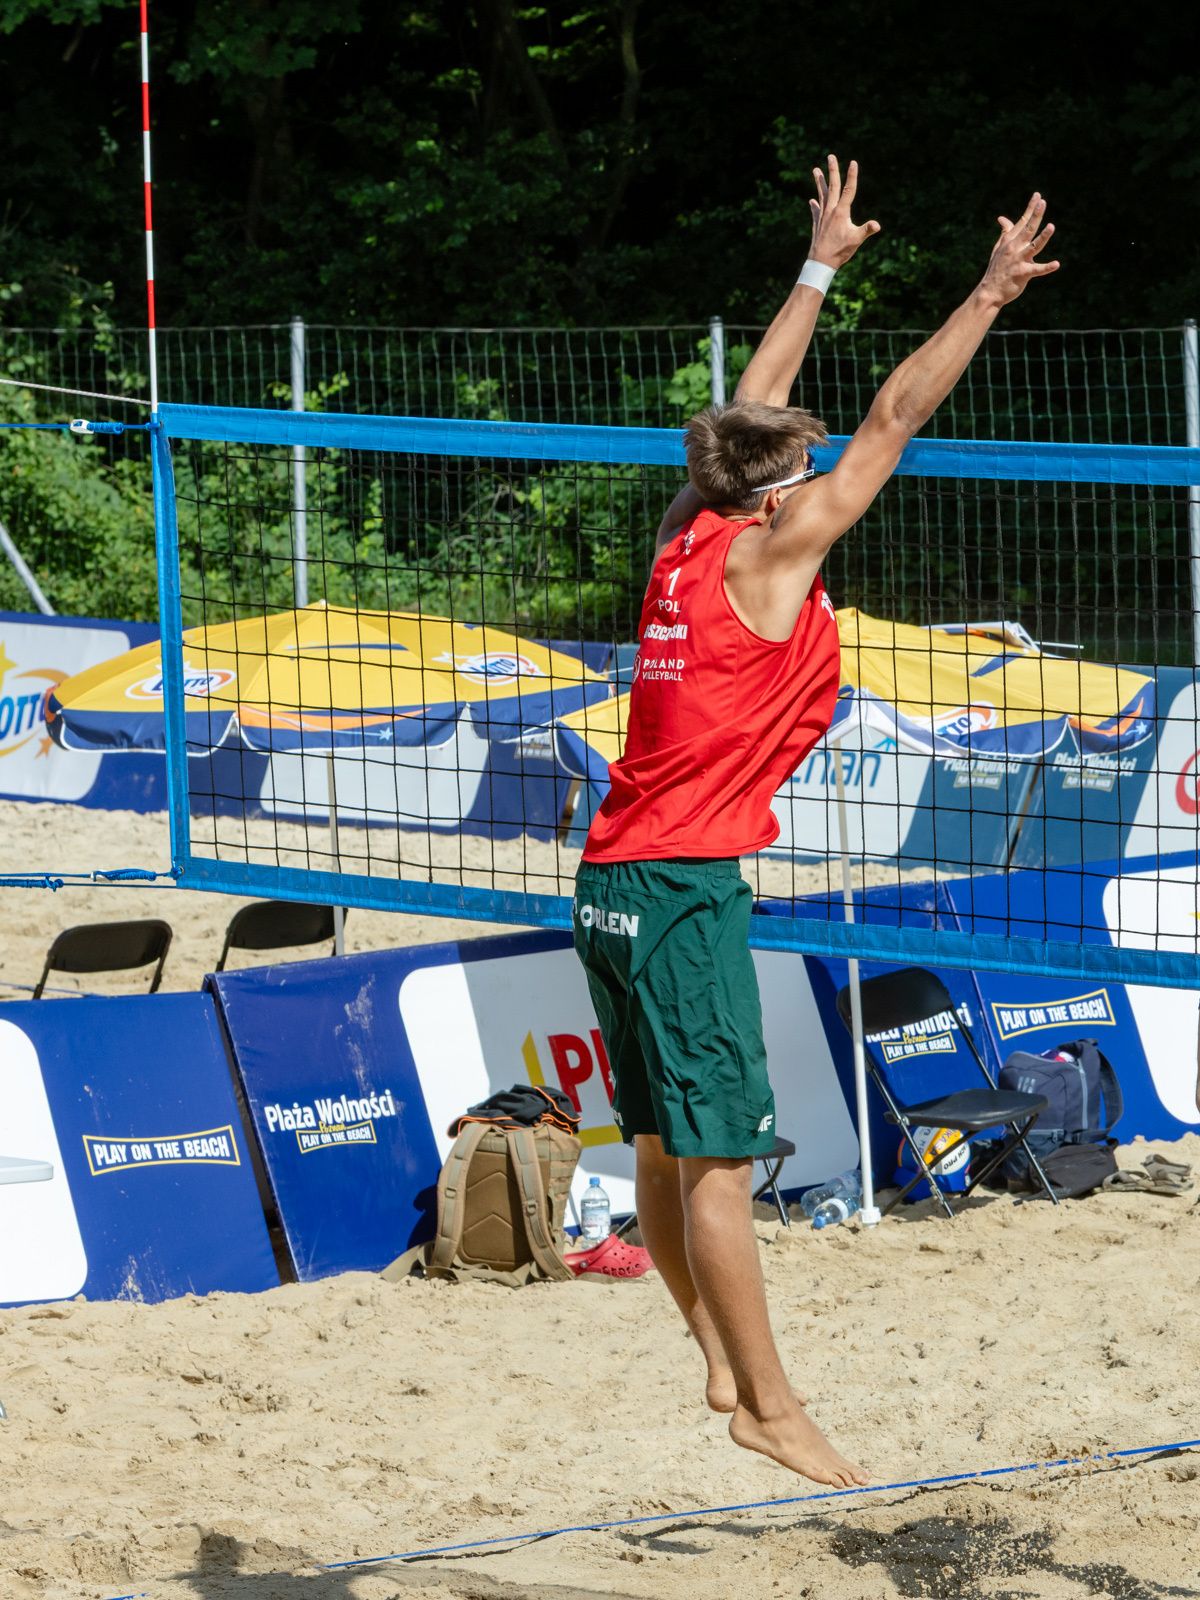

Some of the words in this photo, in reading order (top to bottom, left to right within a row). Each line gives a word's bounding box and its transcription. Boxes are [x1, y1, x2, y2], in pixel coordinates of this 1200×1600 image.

[668, 567, 682, 597] 1
[658, 599, 681, 613] POL
[152, 676, 215, 691] LTTO
[580, 904, 639, 938] ORLEN
[1000, 1009, 1028, 1031] PLAY
[1029, 1008, 1047, 1025] ON
[1046, 1005, 1069, 1022] THE
[1069, 998, 1107, 1020] BEACH
[886, 1045, 904, 1059] PLAY
[904, 1044, 915, 1054] ON
[915, 1042, 929, 1052] THE
[928, 1037, 951, 1051] BEACH
[264, 1102, 316, 1132] Plaża
[314, 1089, 396, 1125] Wolności
[93, 1143, 128, 1166] PLAY
[131, 1144, 153, 1161] ON
[153, 1141, 182, 1159] THE
[183, 1135, 231, 1158] BEACH
[301, 1134, 320, 1149] PLAY
[320, 1133, 332, 1144] ON
[332, 1131, 346, 1142] THE
[346, 1126, 372, 1141] BEACH
